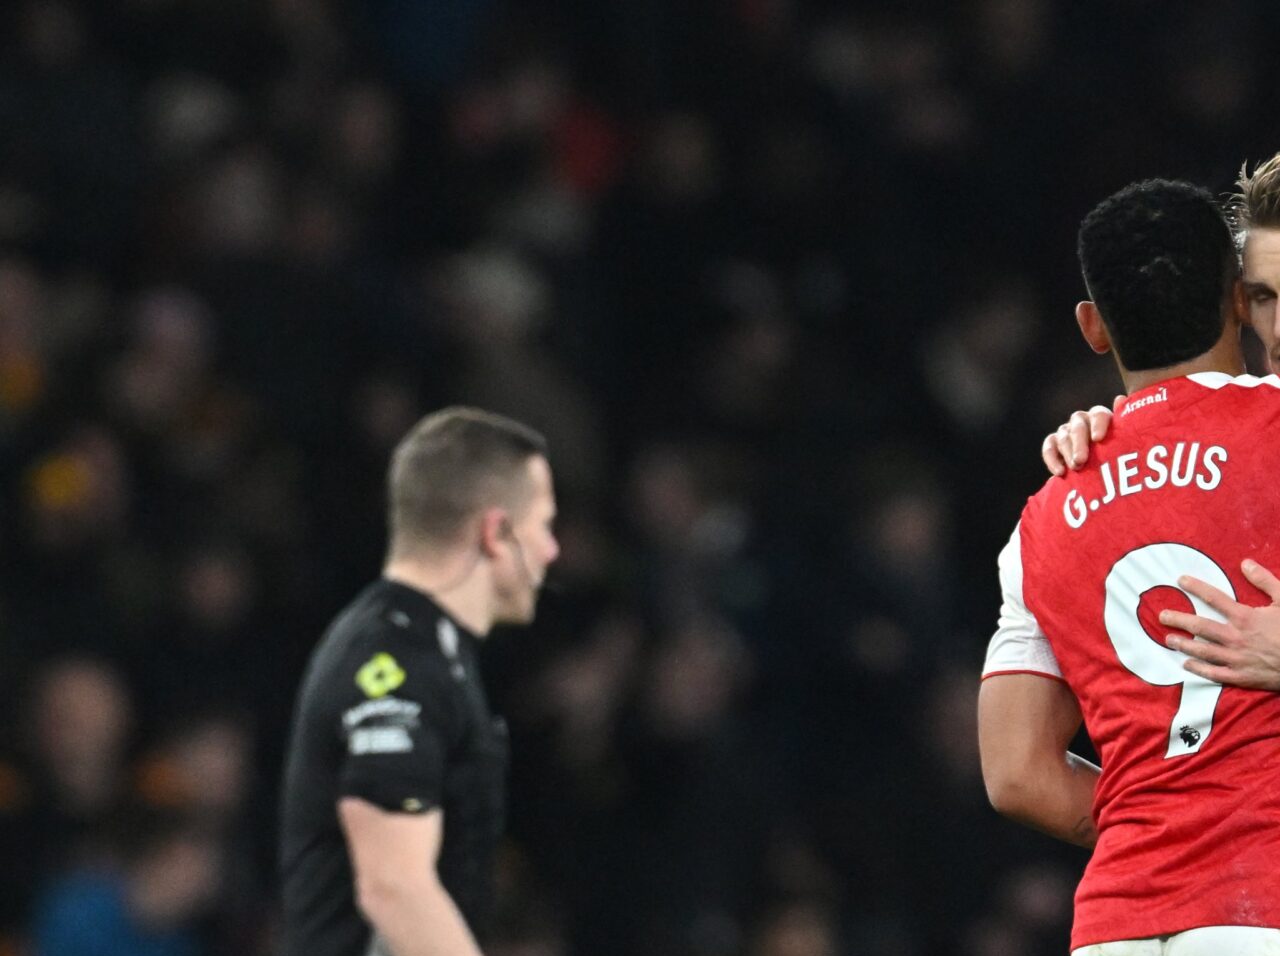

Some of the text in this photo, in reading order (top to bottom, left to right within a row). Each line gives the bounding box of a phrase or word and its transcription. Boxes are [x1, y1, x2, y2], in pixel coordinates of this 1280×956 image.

[1120, 386, 1168, 417] Arsenal
[1063, 442, 1228, 529] G.JESUS
[1104, 542, 1238, 760] 9
